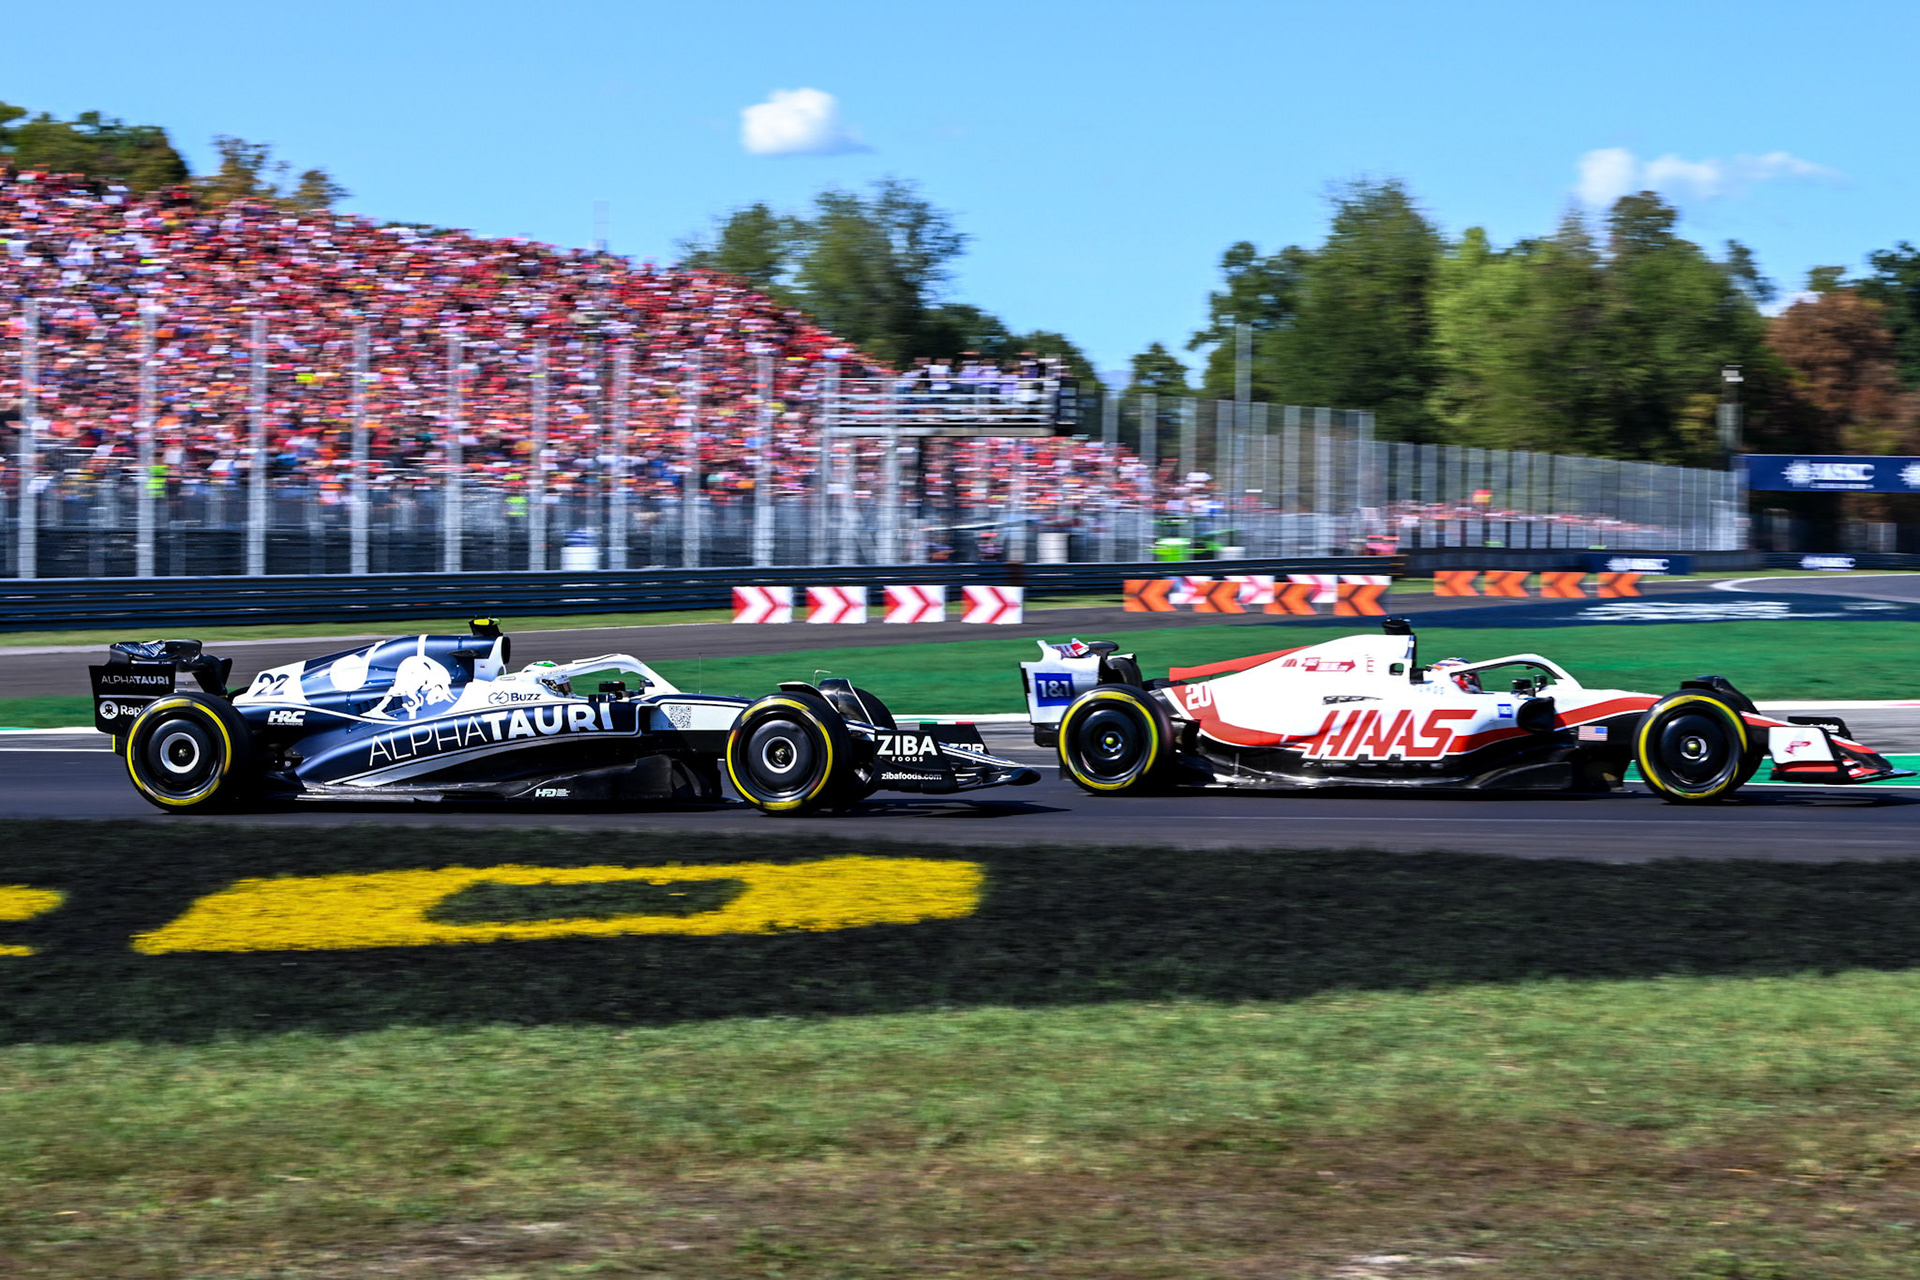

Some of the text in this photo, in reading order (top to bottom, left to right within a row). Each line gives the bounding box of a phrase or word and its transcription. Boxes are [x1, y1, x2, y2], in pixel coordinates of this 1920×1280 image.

[101, 675, 170, 685] ALPHATAURI
[253, 672, 290, 698] 22
[1037, 680, 1071, 698] 1&1
[1185, 681, 1212, 710] 20
[268, 710, 306, 723] HRC
[369, 702, 615, 767] ALPHATAURI
[1308, 708, 1477, 758] HAAS
[877, 735, 938, 756] ZIBA
[881, 771, 942, 780] zibafoods.com
